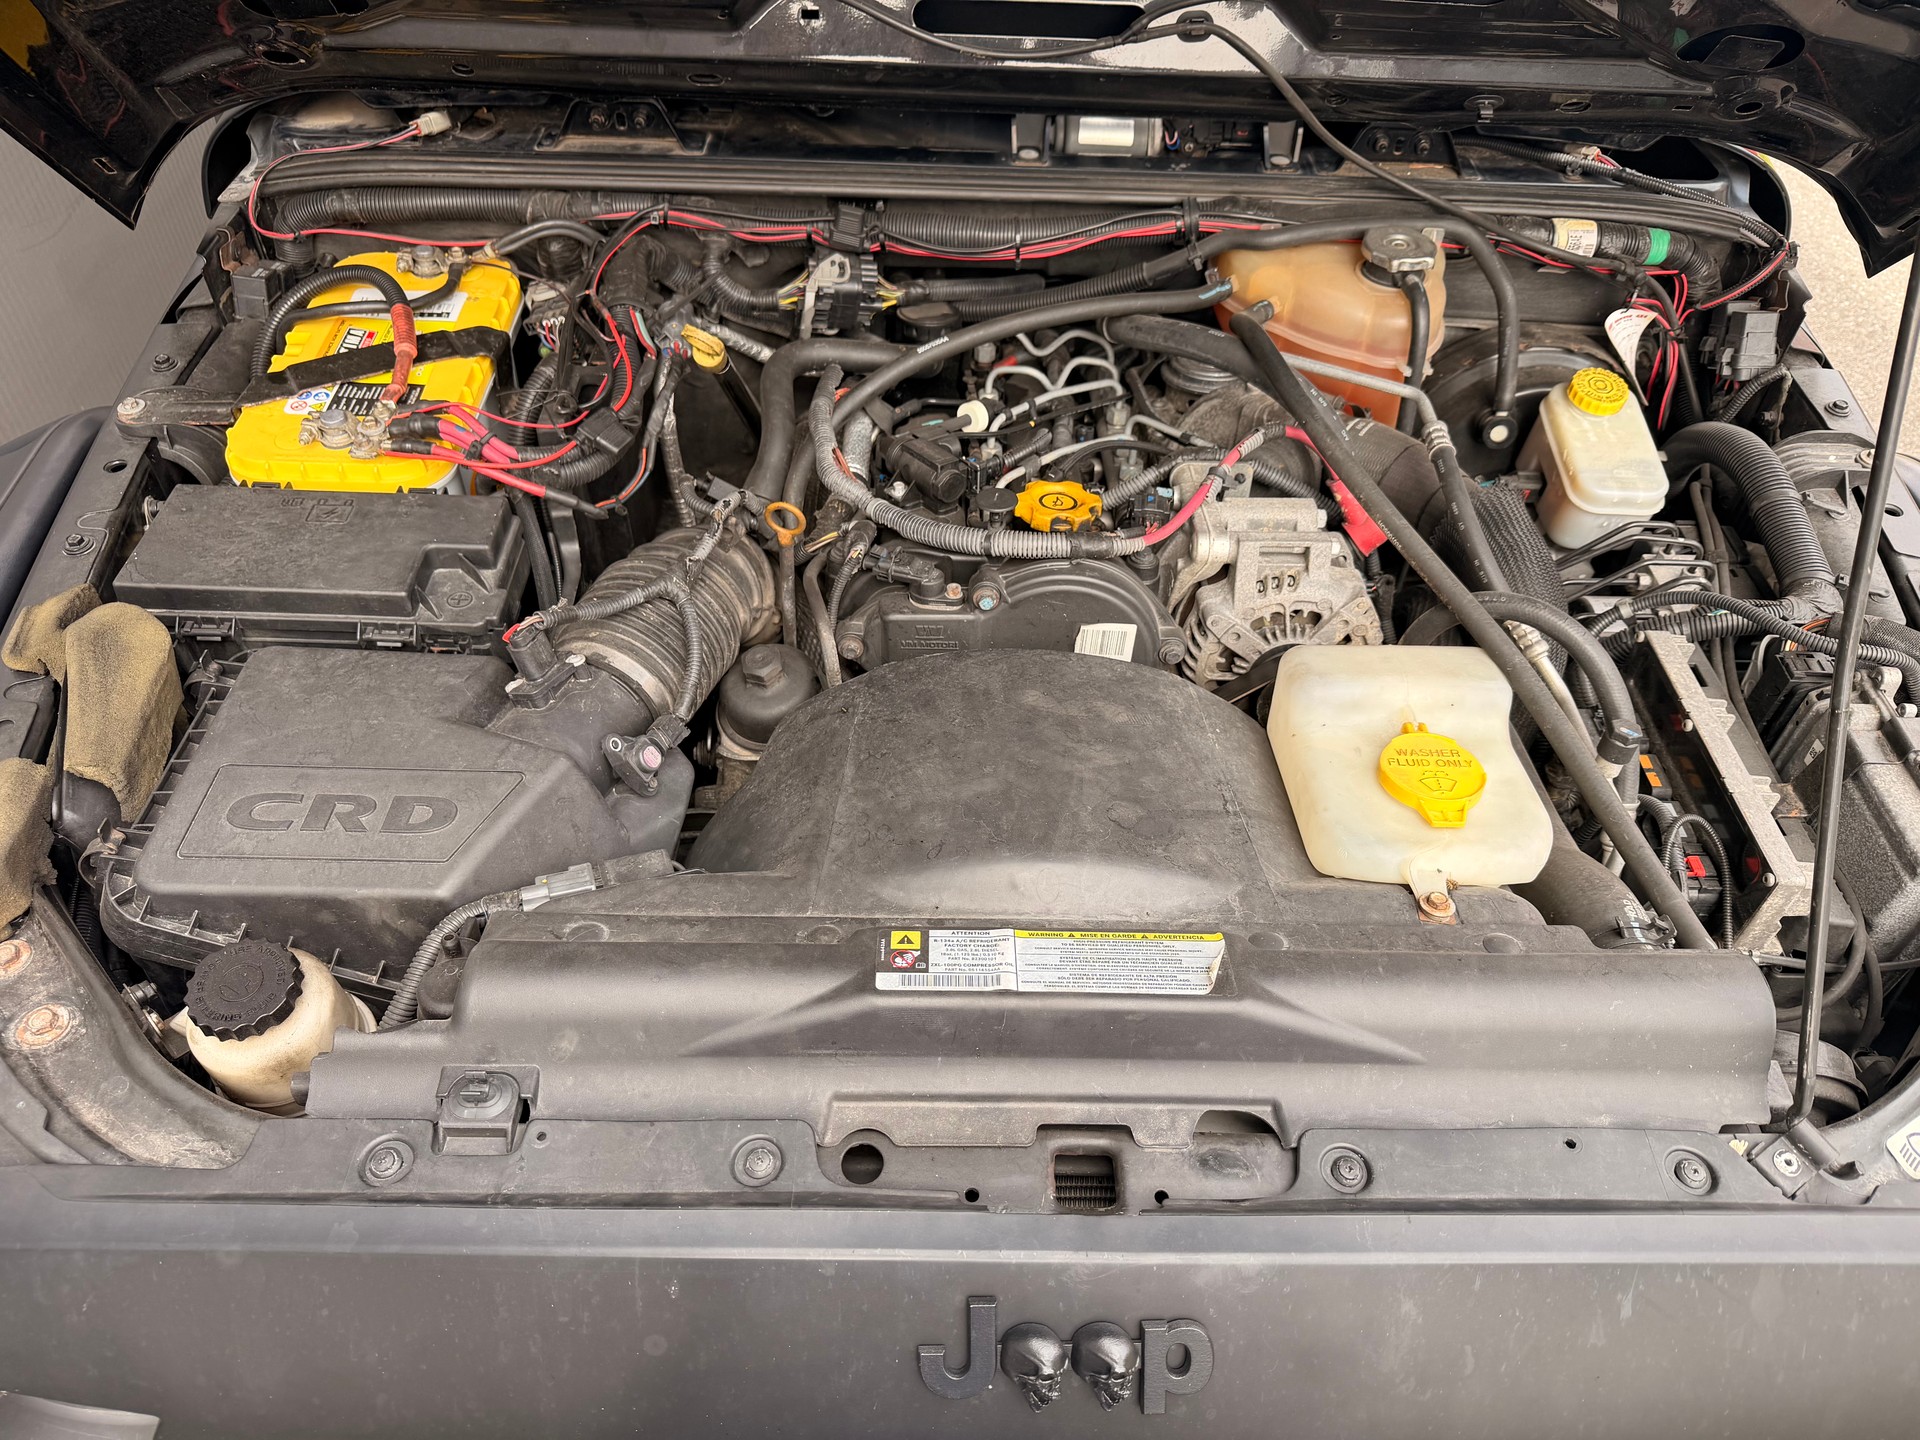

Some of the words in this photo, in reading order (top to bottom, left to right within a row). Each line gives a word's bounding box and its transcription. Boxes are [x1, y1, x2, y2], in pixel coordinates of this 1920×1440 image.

[1394, 748, 1460, 758] WASHER
[1387, 758, 1430, 767] FLUID
[1435, 759, 1472, 768] ONLY
[226, 792, 459, 834] CRD
